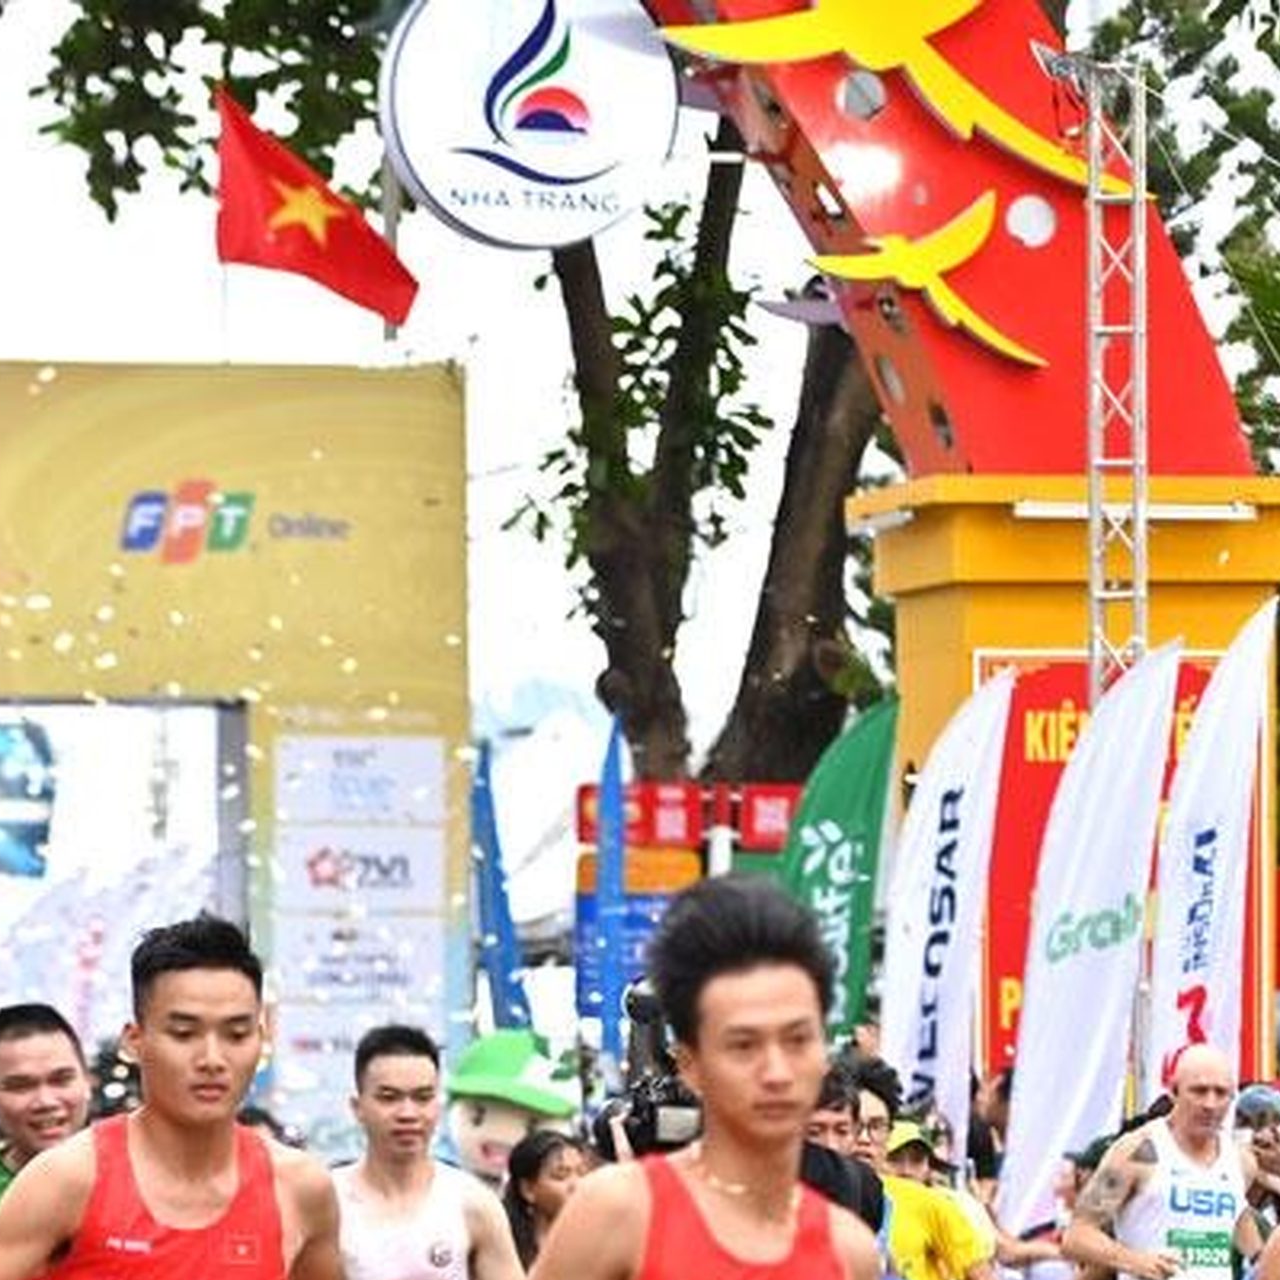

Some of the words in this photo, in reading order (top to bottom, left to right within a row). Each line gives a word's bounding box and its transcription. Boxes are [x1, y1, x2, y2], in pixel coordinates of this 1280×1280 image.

[450, 188, 510, 208] NHA
[522, 190, 621, 215] TRANG
[1169, 1183, 1237, 1219] USA
